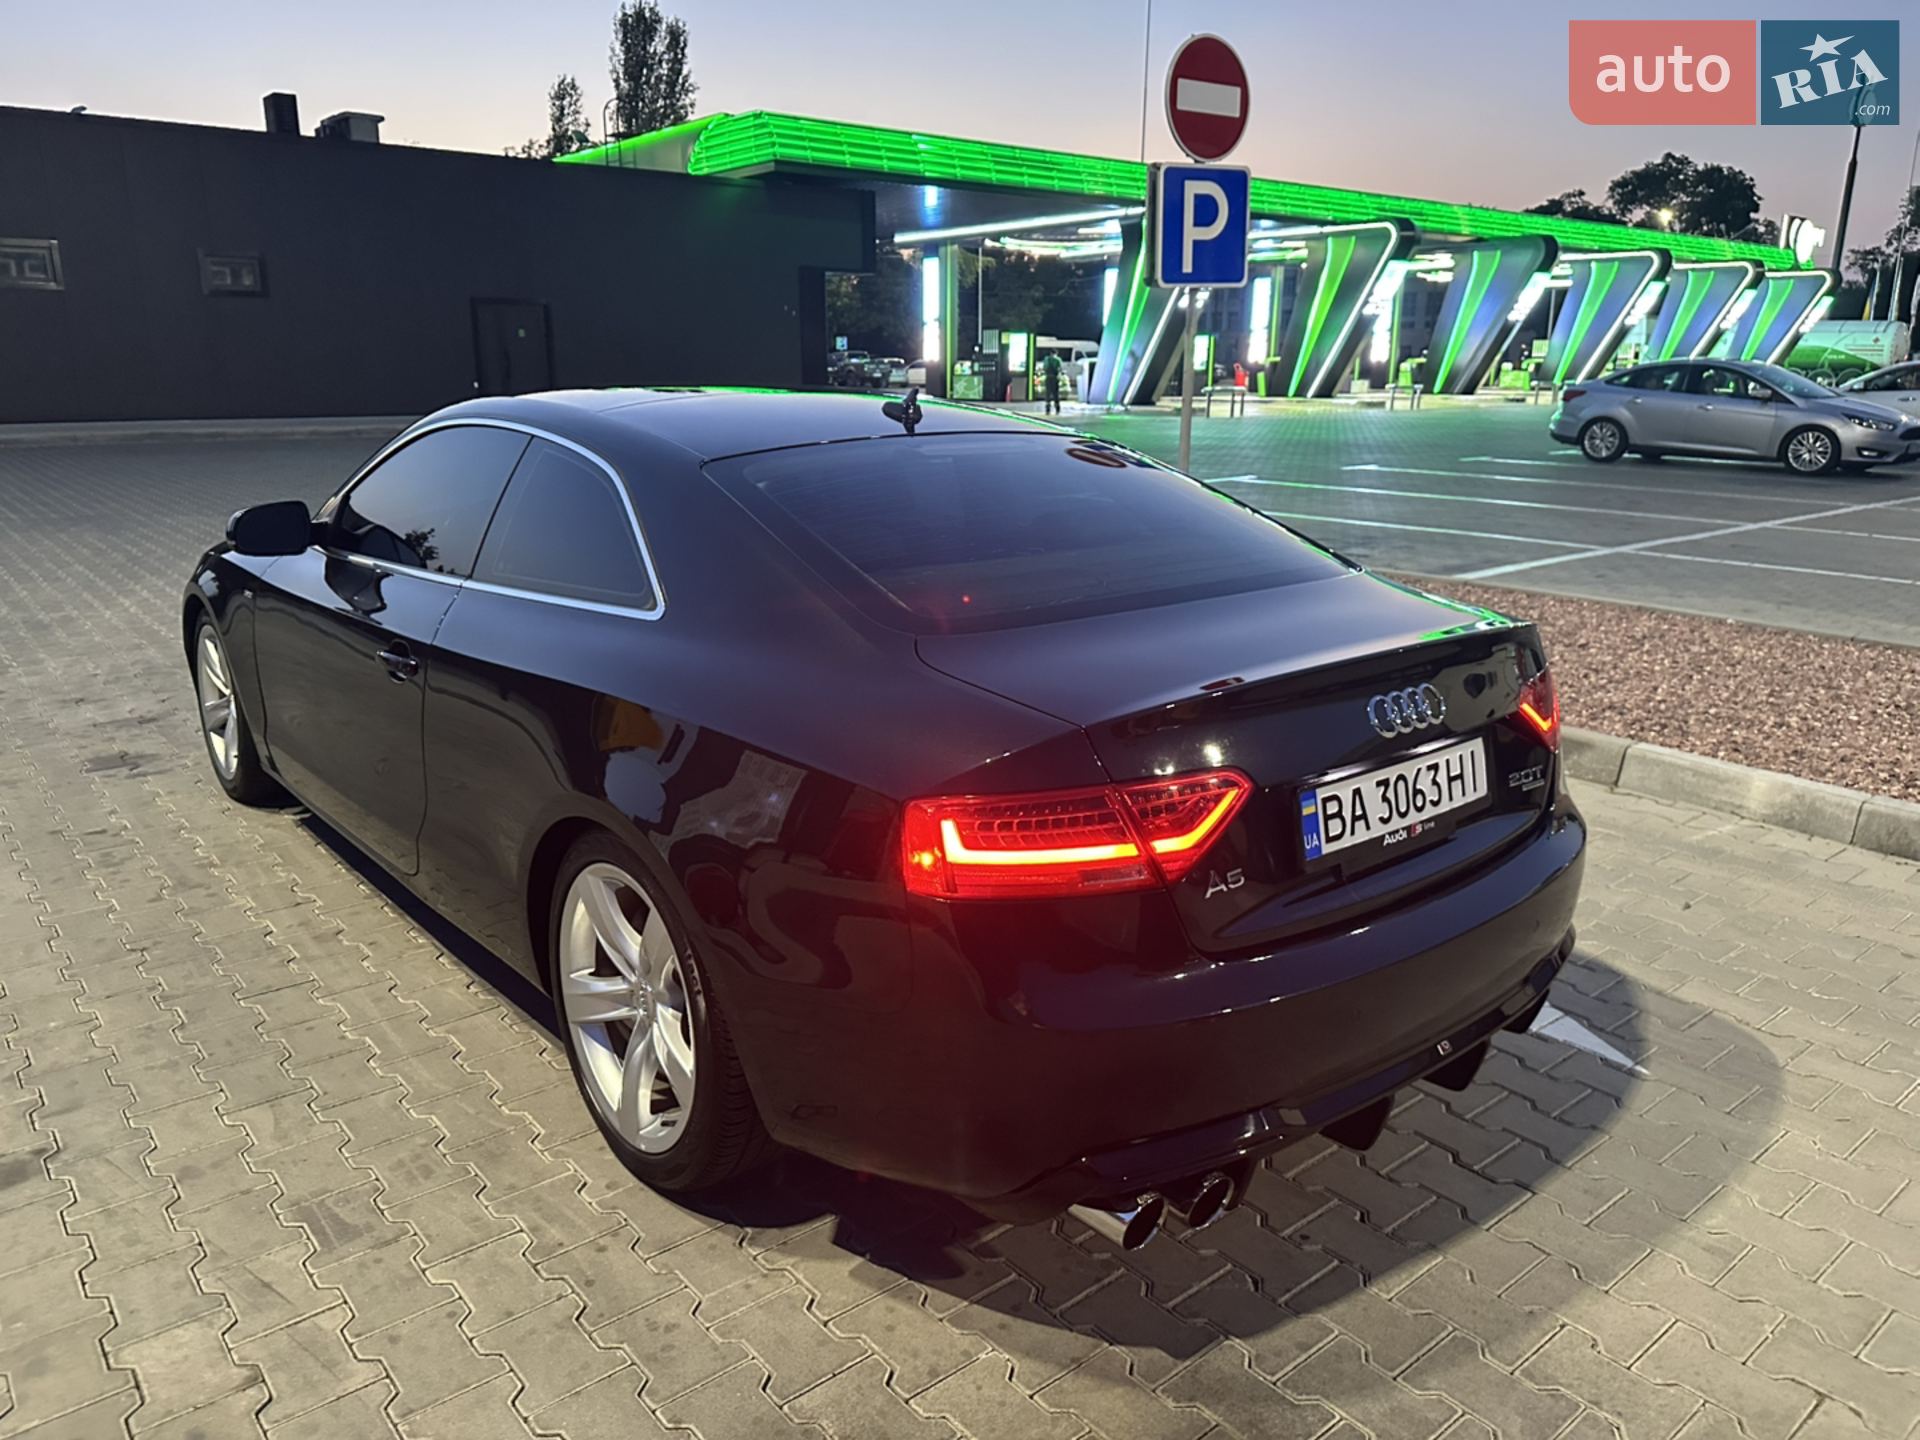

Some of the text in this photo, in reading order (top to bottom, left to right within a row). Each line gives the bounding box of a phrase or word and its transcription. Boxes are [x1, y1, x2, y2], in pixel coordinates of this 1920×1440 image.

[1182, 179, 1229, 274] P
[1303, 832, 1320, 849] UA
[1204, 867, 1245, 899] A5
